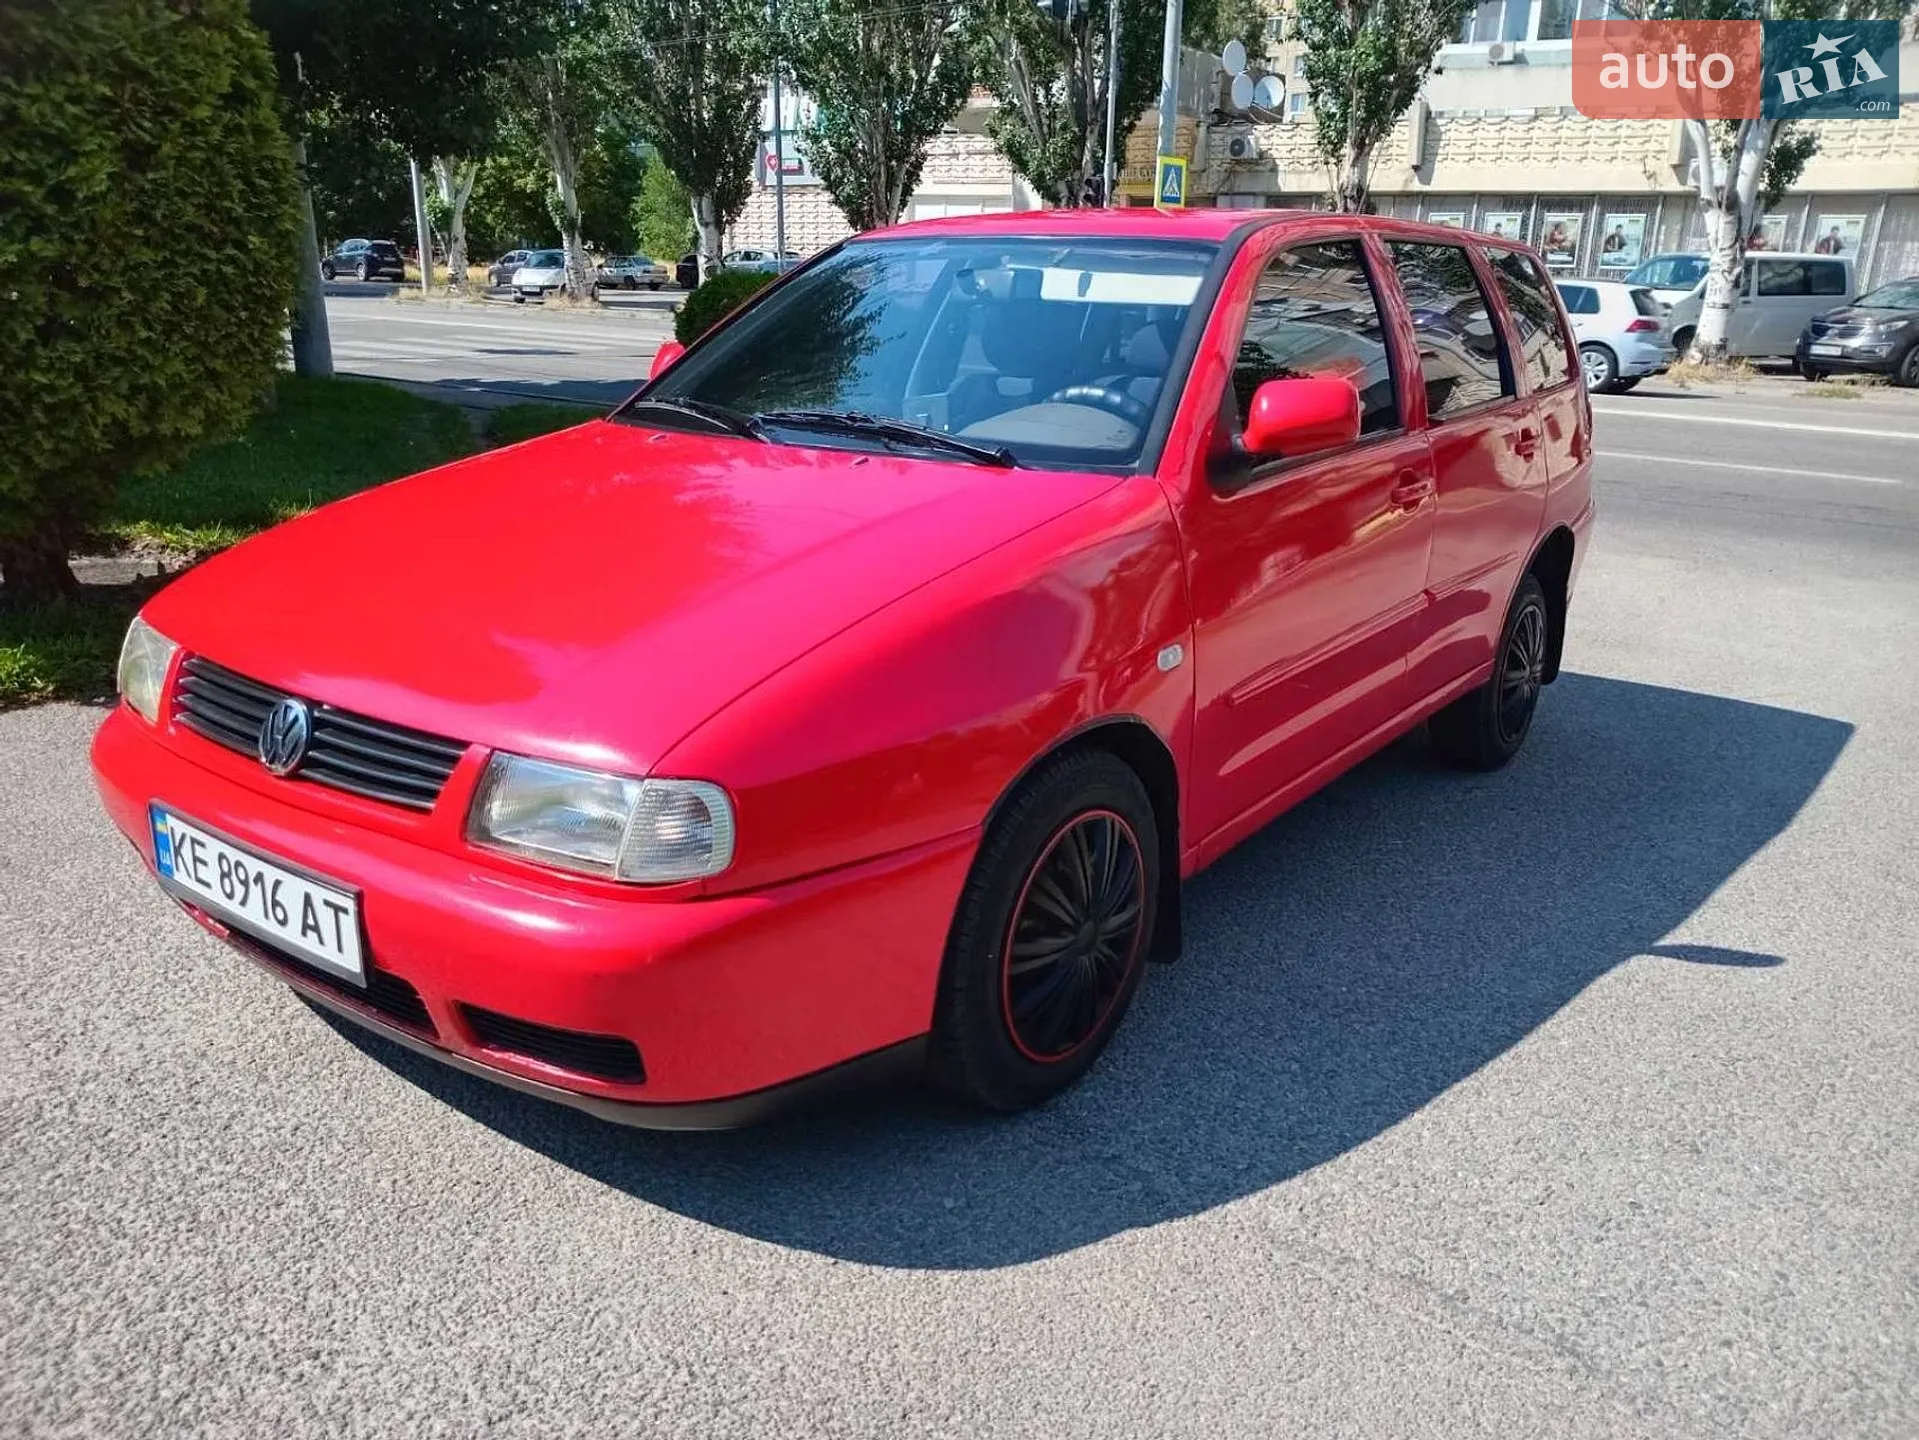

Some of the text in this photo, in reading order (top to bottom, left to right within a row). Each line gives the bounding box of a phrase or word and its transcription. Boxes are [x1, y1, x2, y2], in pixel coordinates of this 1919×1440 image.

[171, 826, 349, 954] KE 8916 AT
